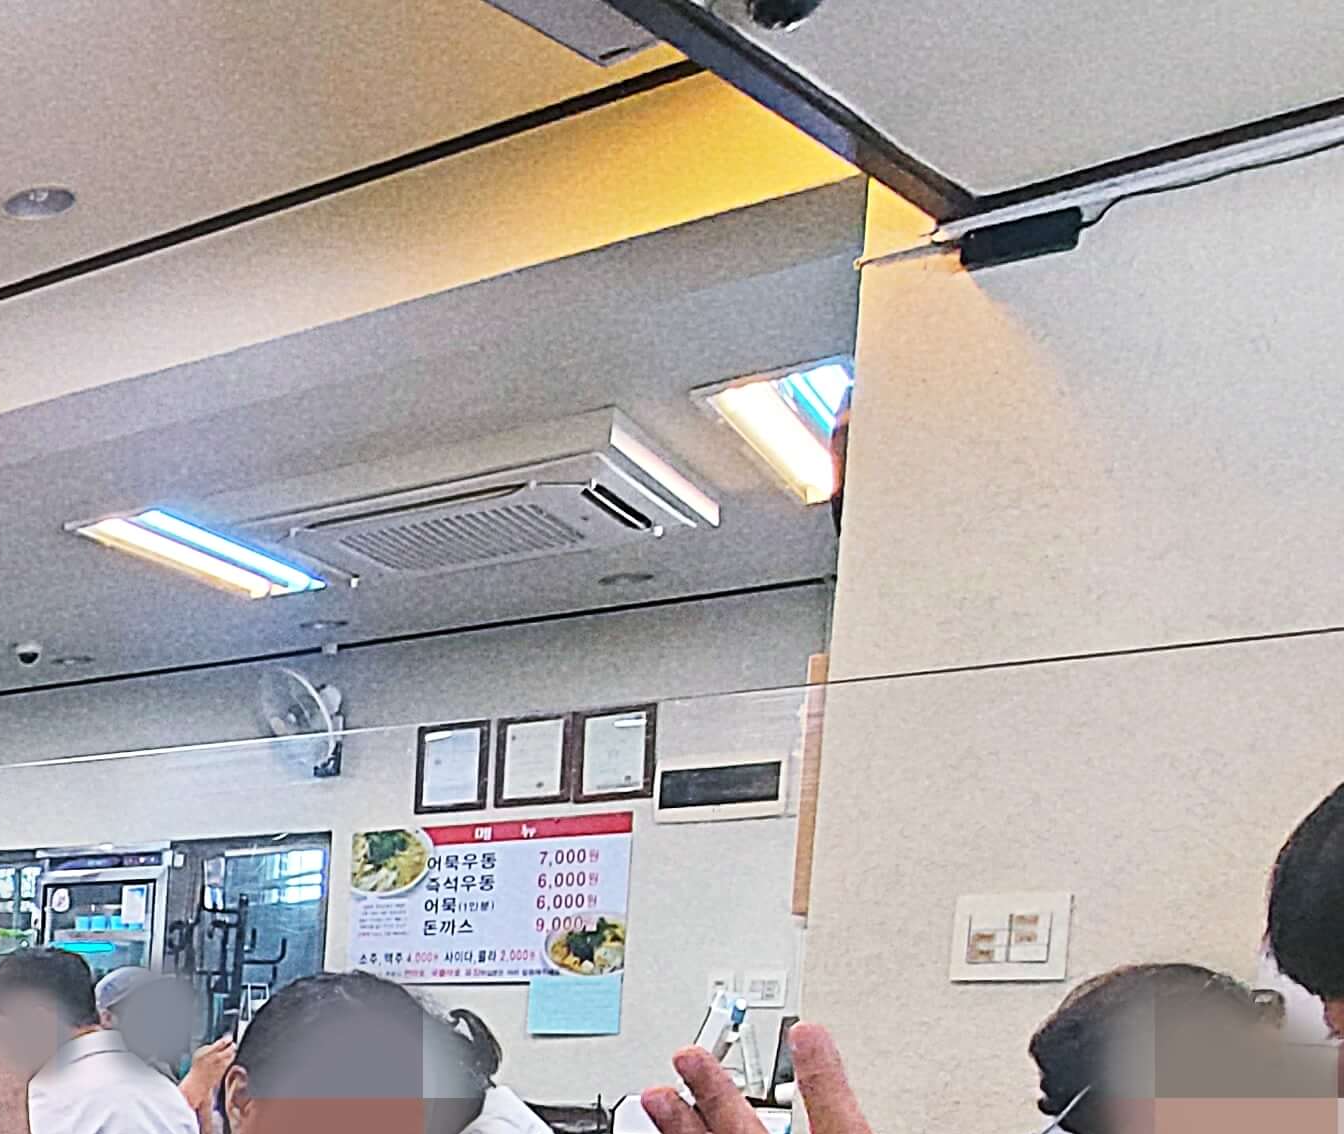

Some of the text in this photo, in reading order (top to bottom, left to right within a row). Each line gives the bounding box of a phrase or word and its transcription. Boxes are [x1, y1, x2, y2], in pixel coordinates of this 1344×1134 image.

[427, 852, 497, 871] 어묵우동
[426, 874, 496, 893] 즉석우동
[423, 919, 474, 937] 돈까스
